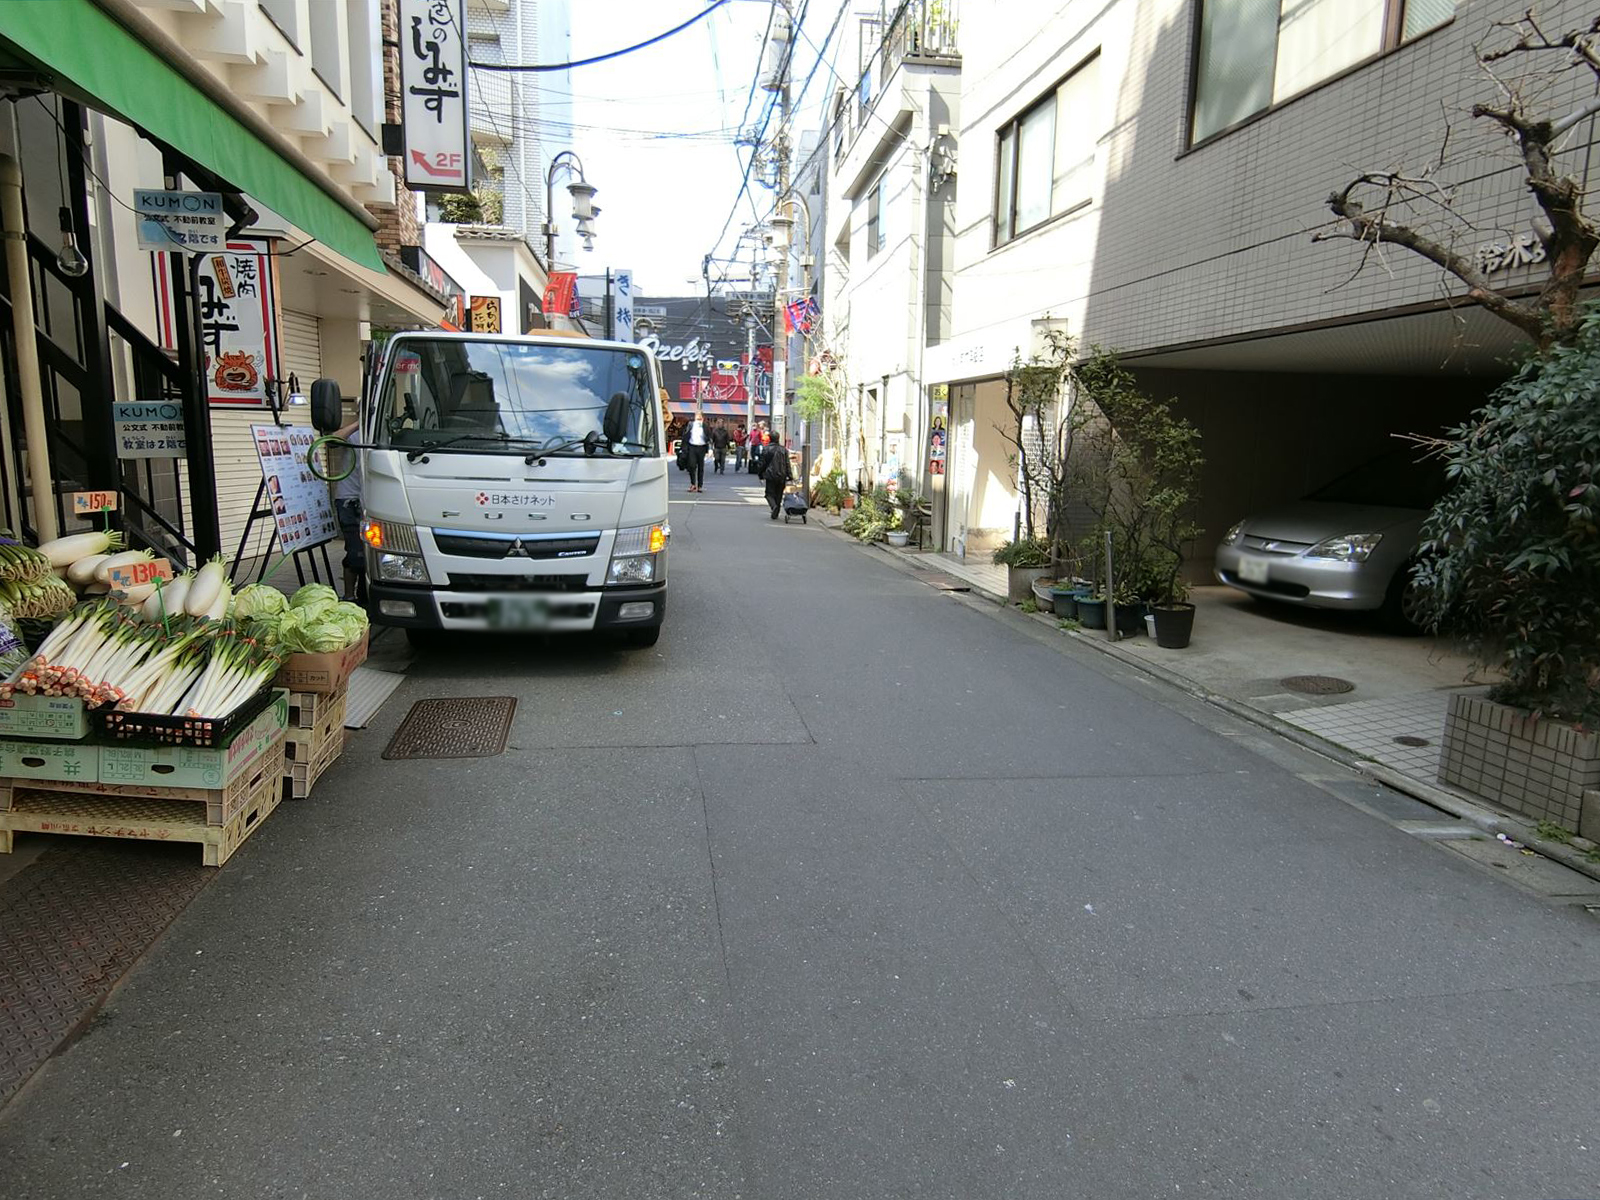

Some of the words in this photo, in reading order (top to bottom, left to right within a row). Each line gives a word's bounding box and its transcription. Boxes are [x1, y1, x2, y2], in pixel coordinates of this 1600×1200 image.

[427, 0, 453, 43] さんの
[409, 15, 460, 124] しみず
[435, 152, 462, 168] 2F
[142, 195, 215, 212] KUMON
[173, 215, 216, 225] 不動前教室
[230, 257, 257, 298] 焼肉
[486, 300, 499, 334] らあめ
[638, 333, 711, 362] Ozeki
[122, 423, 148, 432] 公文式
[491, 494, 556, 507] 日本さけネット
[442, 510, 591, 522] FUSO
